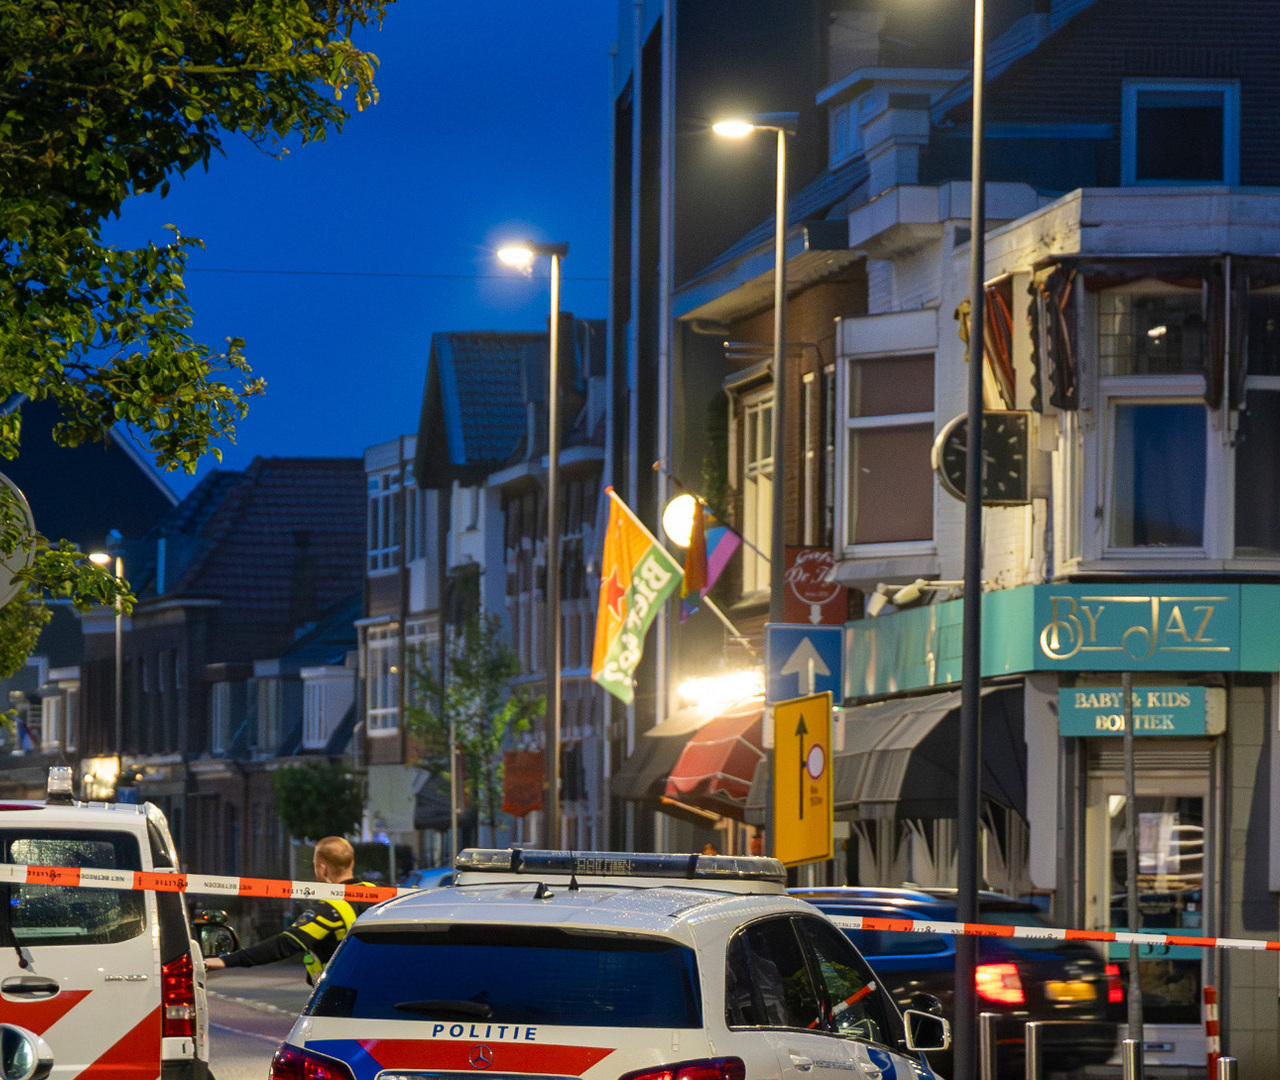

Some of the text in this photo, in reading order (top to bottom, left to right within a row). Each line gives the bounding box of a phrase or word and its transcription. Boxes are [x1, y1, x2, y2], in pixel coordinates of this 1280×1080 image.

[1039, 595, 1217, 661] BY JAZ
[1074, 691, 1124, 709] BABY
[1147, 691, 1191, 708] KIDS
[1095, 713, 1176, 732] BOTIEK
[203, 881, 237, 890] BETREDEN
[431, 1023, 538, 1041] POLITIE
